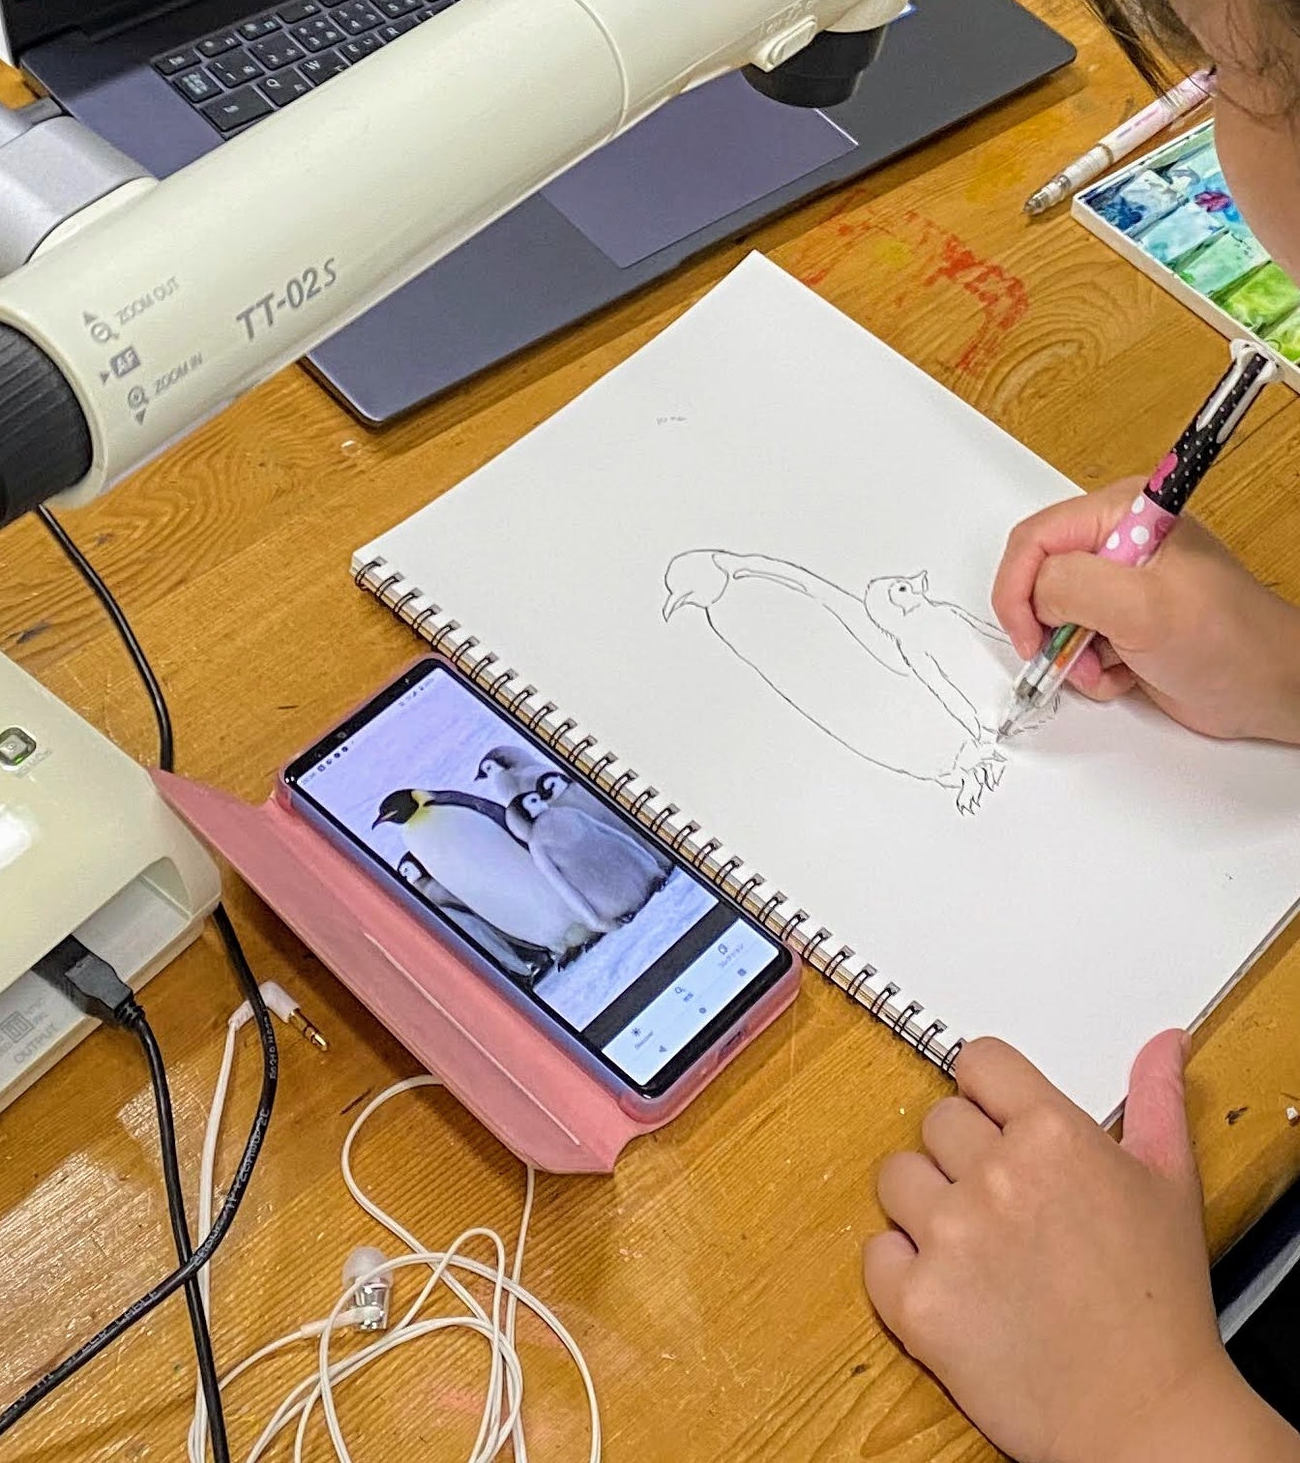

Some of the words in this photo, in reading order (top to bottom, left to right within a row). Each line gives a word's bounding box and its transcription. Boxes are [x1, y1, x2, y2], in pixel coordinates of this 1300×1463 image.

[115, 289, 156, 325] ZOOM
[153, 275, 181, 303] OUT
[235, 257, 337, 343] TT-02S
[114, 349, 137, 375] AF
[154, 363, 190, 395] ZOOM
[187, 351, 204, 371] IN
[12, 1023, 60, 1064] OUTPUT
